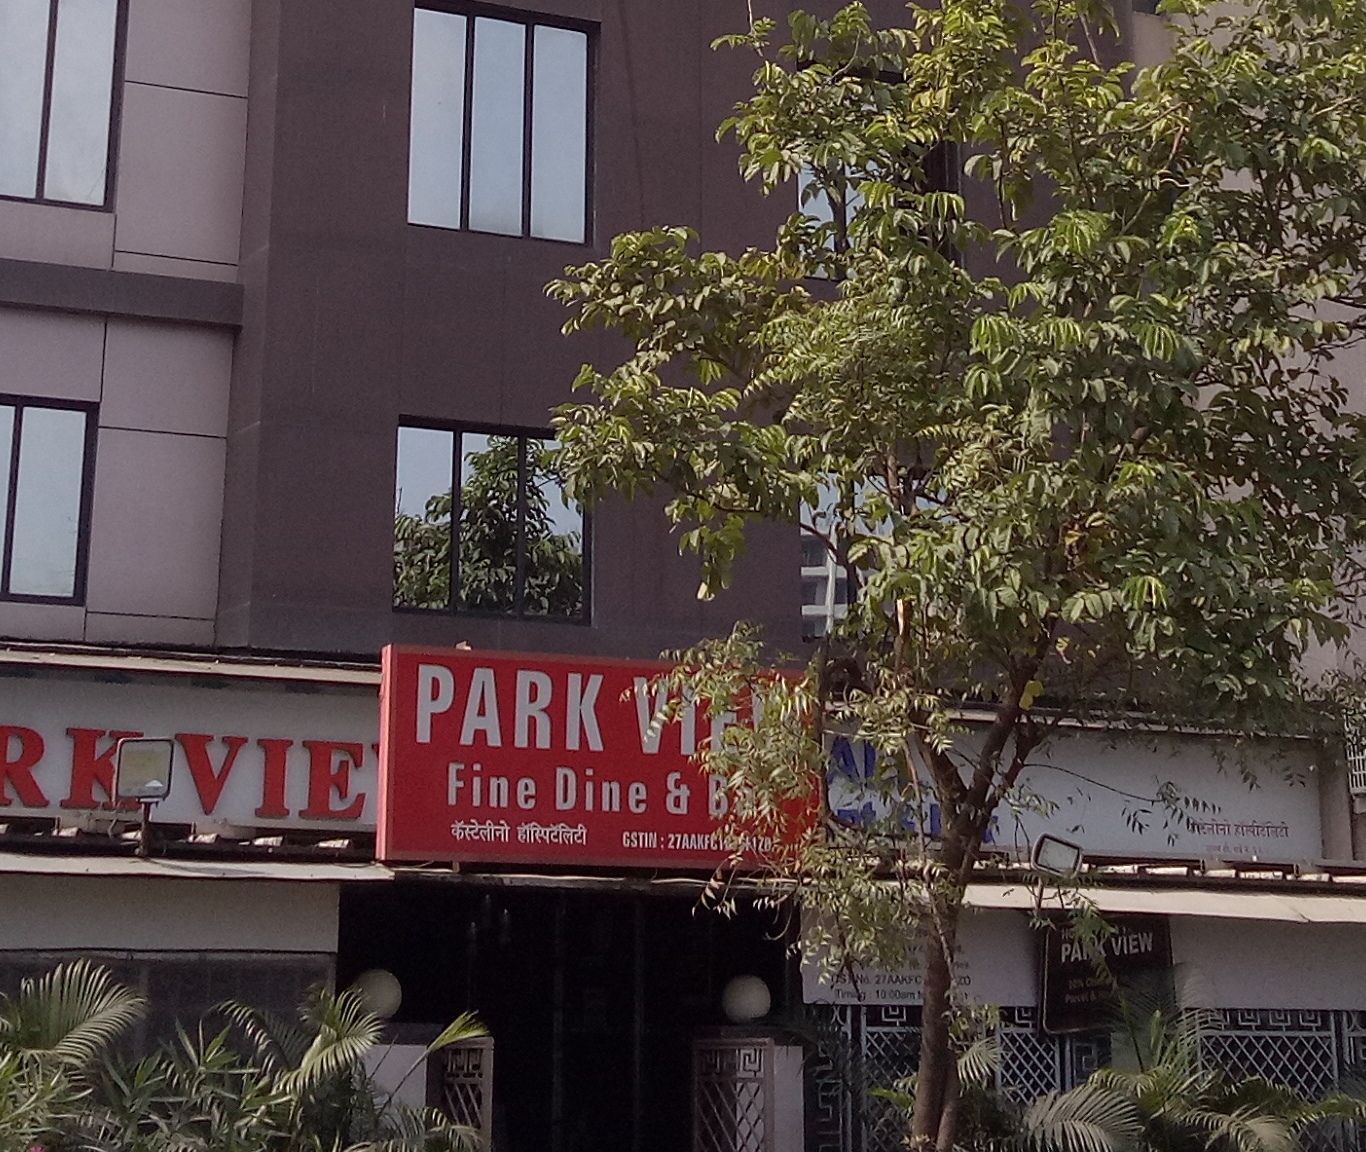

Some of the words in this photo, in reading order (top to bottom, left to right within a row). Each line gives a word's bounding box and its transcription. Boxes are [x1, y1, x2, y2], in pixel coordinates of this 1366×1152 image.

[416, 663, 605, 752] PARK
[633, 676, 767, 756] VIE
[173, 732, 382, 820] VIE
[447, 761, 536, 810] Fine
[555, 766, 648, 814] Dine
[665, 771, 691, 815] &
[622, 831, 658, 849] GSTIN
[1111, 932, 1153, 956] VIEW
